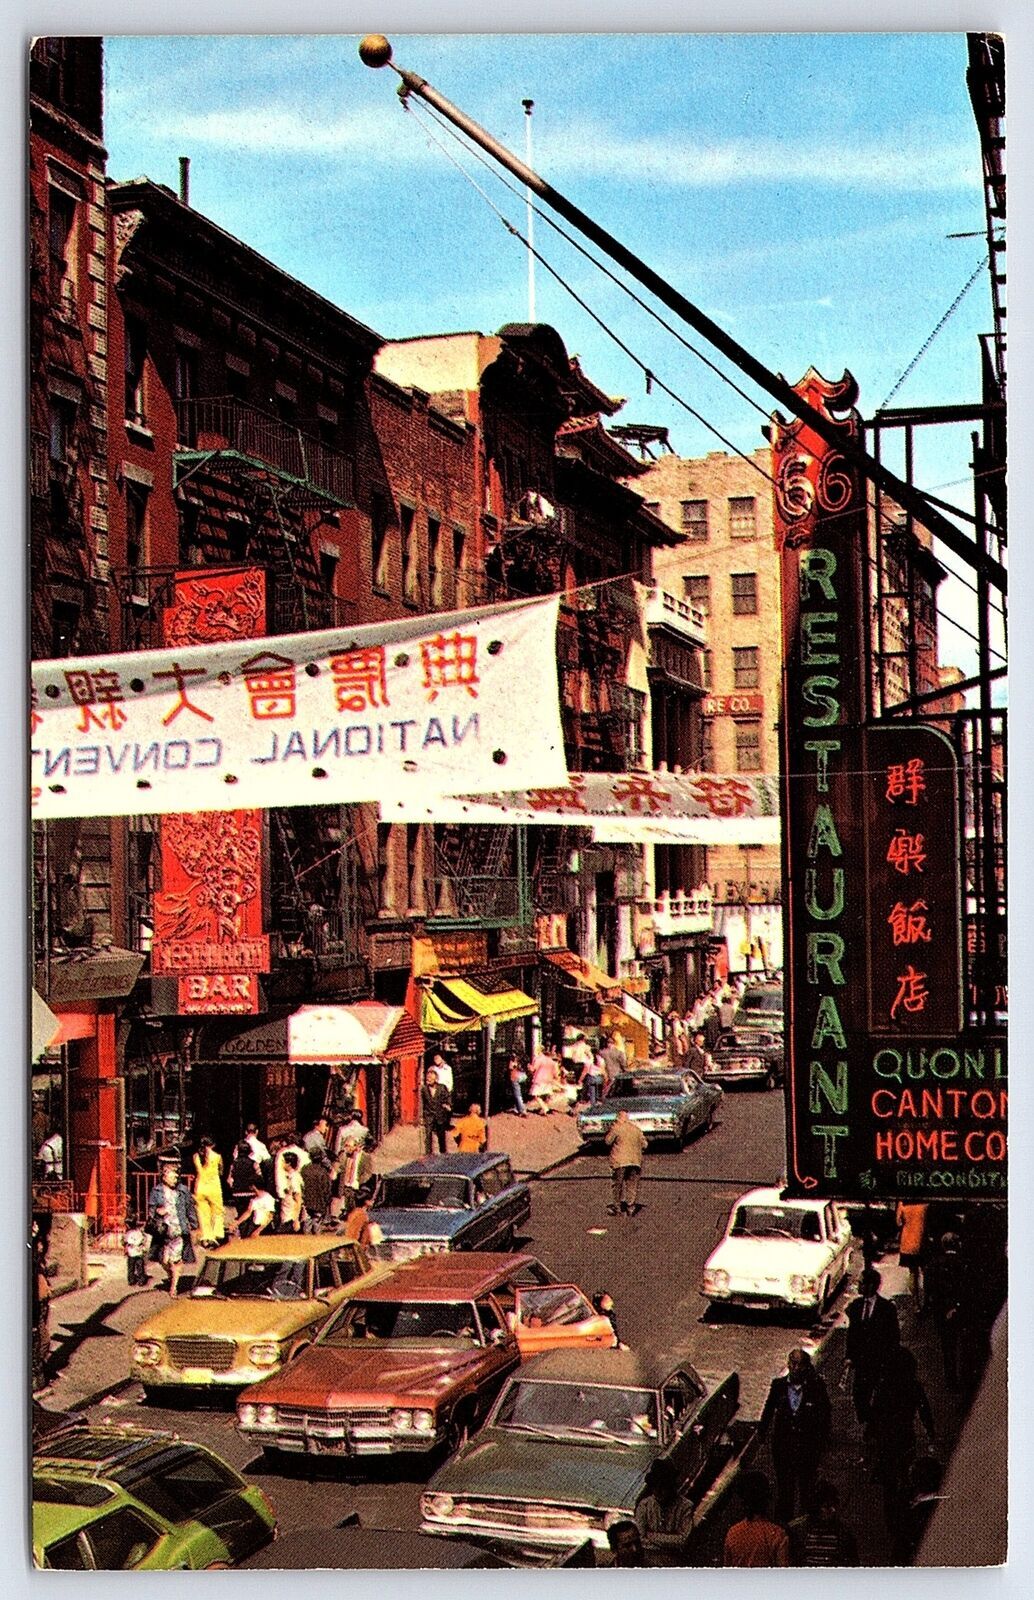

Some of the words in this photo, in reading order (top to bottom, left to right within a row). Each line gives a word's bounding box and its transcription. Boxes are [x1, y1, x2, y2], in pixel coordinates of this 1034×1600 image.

[800, 548, 849, 1178] RESTAURANT
[187, 974, 251, 1000] BAR
[873, 1048, 985, 1084] QUON
[876, 1130, 958, 1161] HOME
[964, 1130, 1007, 1161] CO
